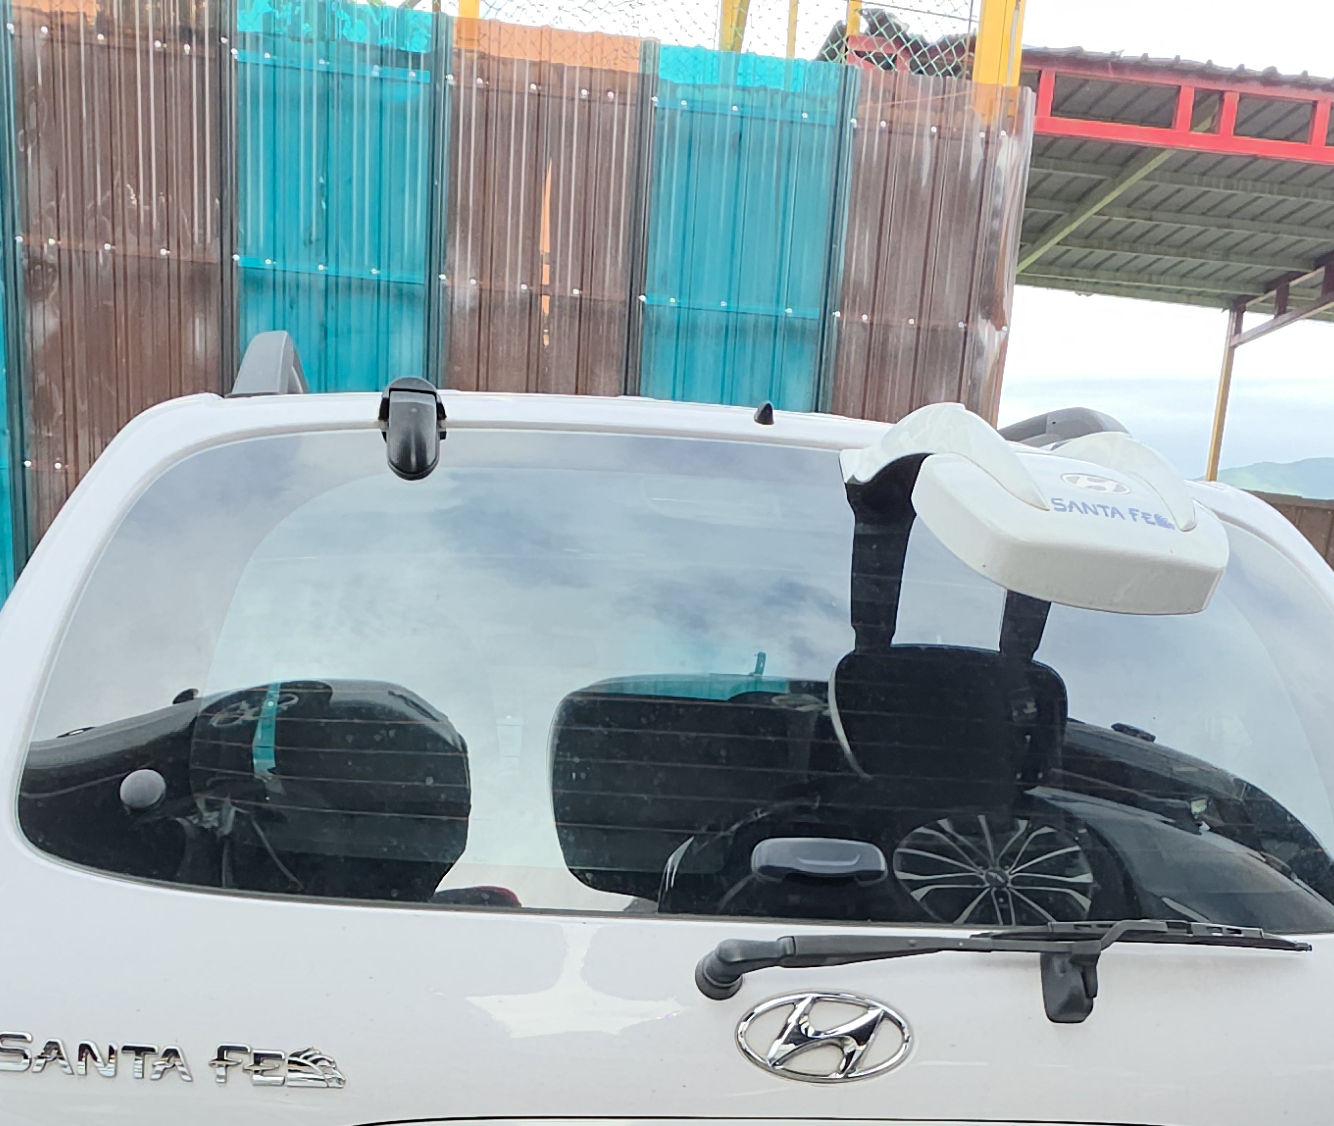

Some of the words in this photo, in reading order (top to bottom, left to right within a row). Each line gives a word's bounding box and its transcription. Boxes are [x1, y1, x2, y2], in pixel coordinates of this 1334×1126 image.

[1051, 498, 1125, 520] SANTA
[1129, 508, 1156, 526] FE
[208, 1042, 287, 1087] FE
